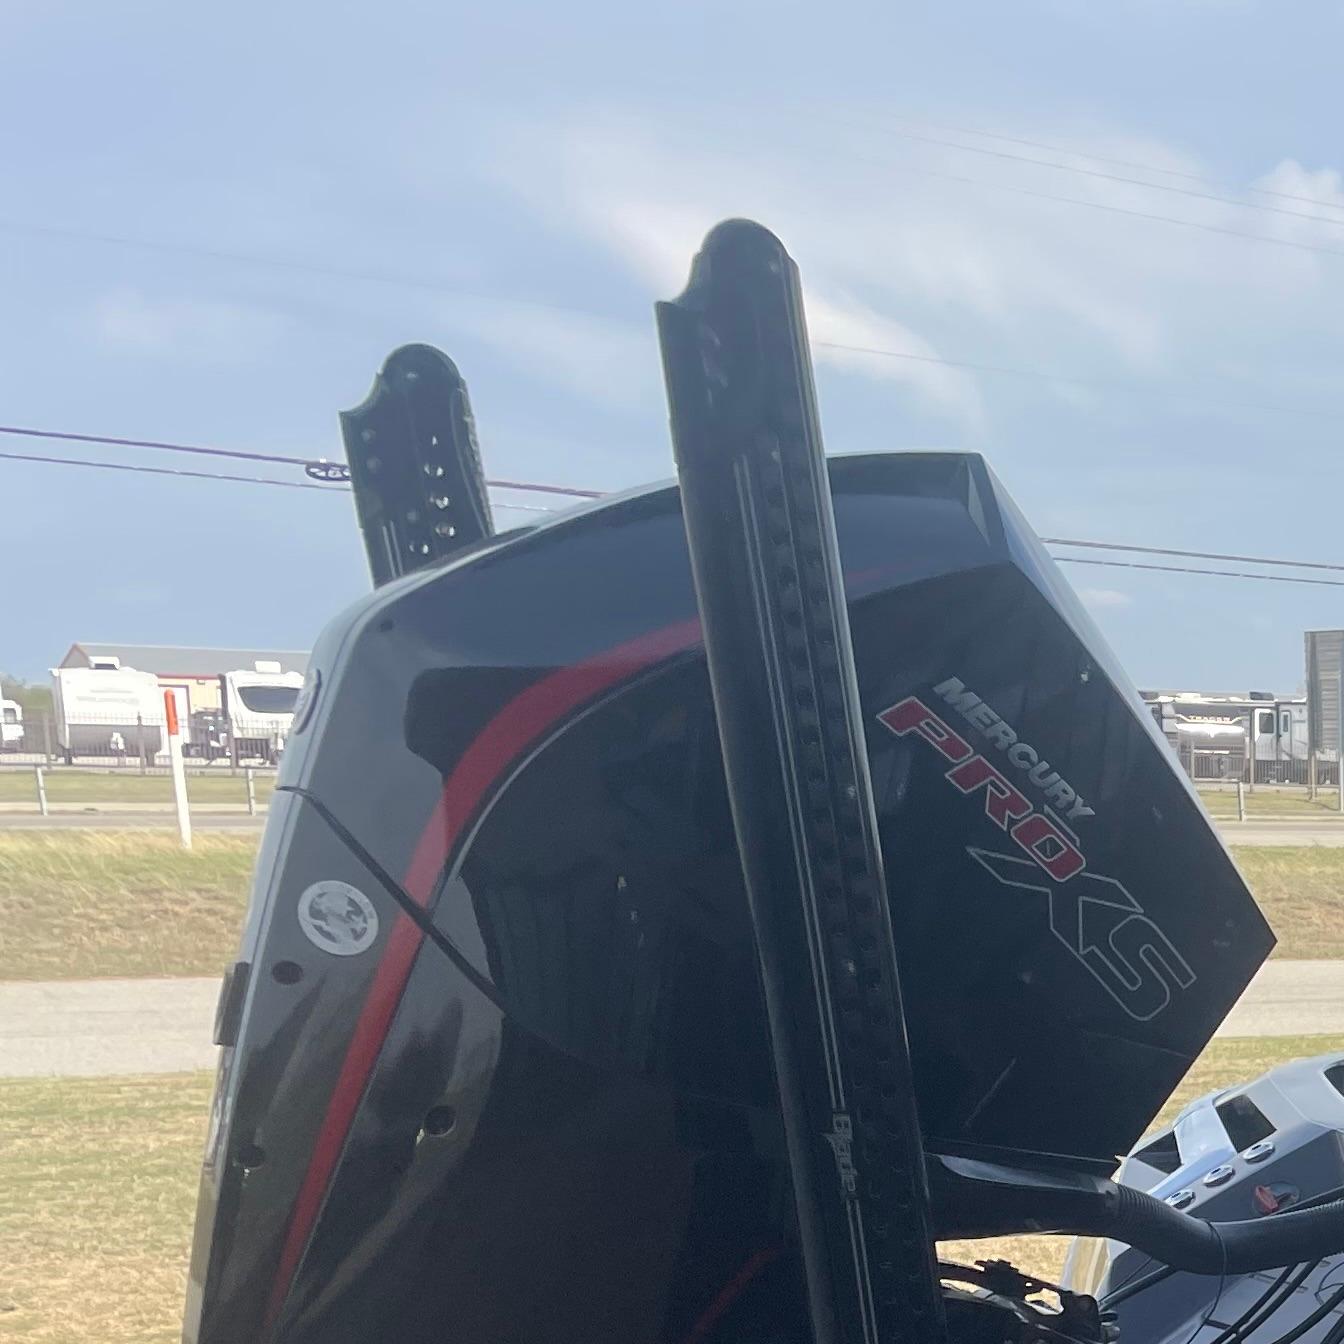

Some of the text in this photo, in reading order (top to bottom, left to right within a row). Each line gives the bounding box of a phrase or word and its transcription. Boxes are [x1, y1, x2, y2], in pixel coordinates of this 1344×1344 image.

[876, 696, 1086, 882] PRO
[932, 676, 1095, 820] MERCURY
[966, 804, 1197, 1021] XS
